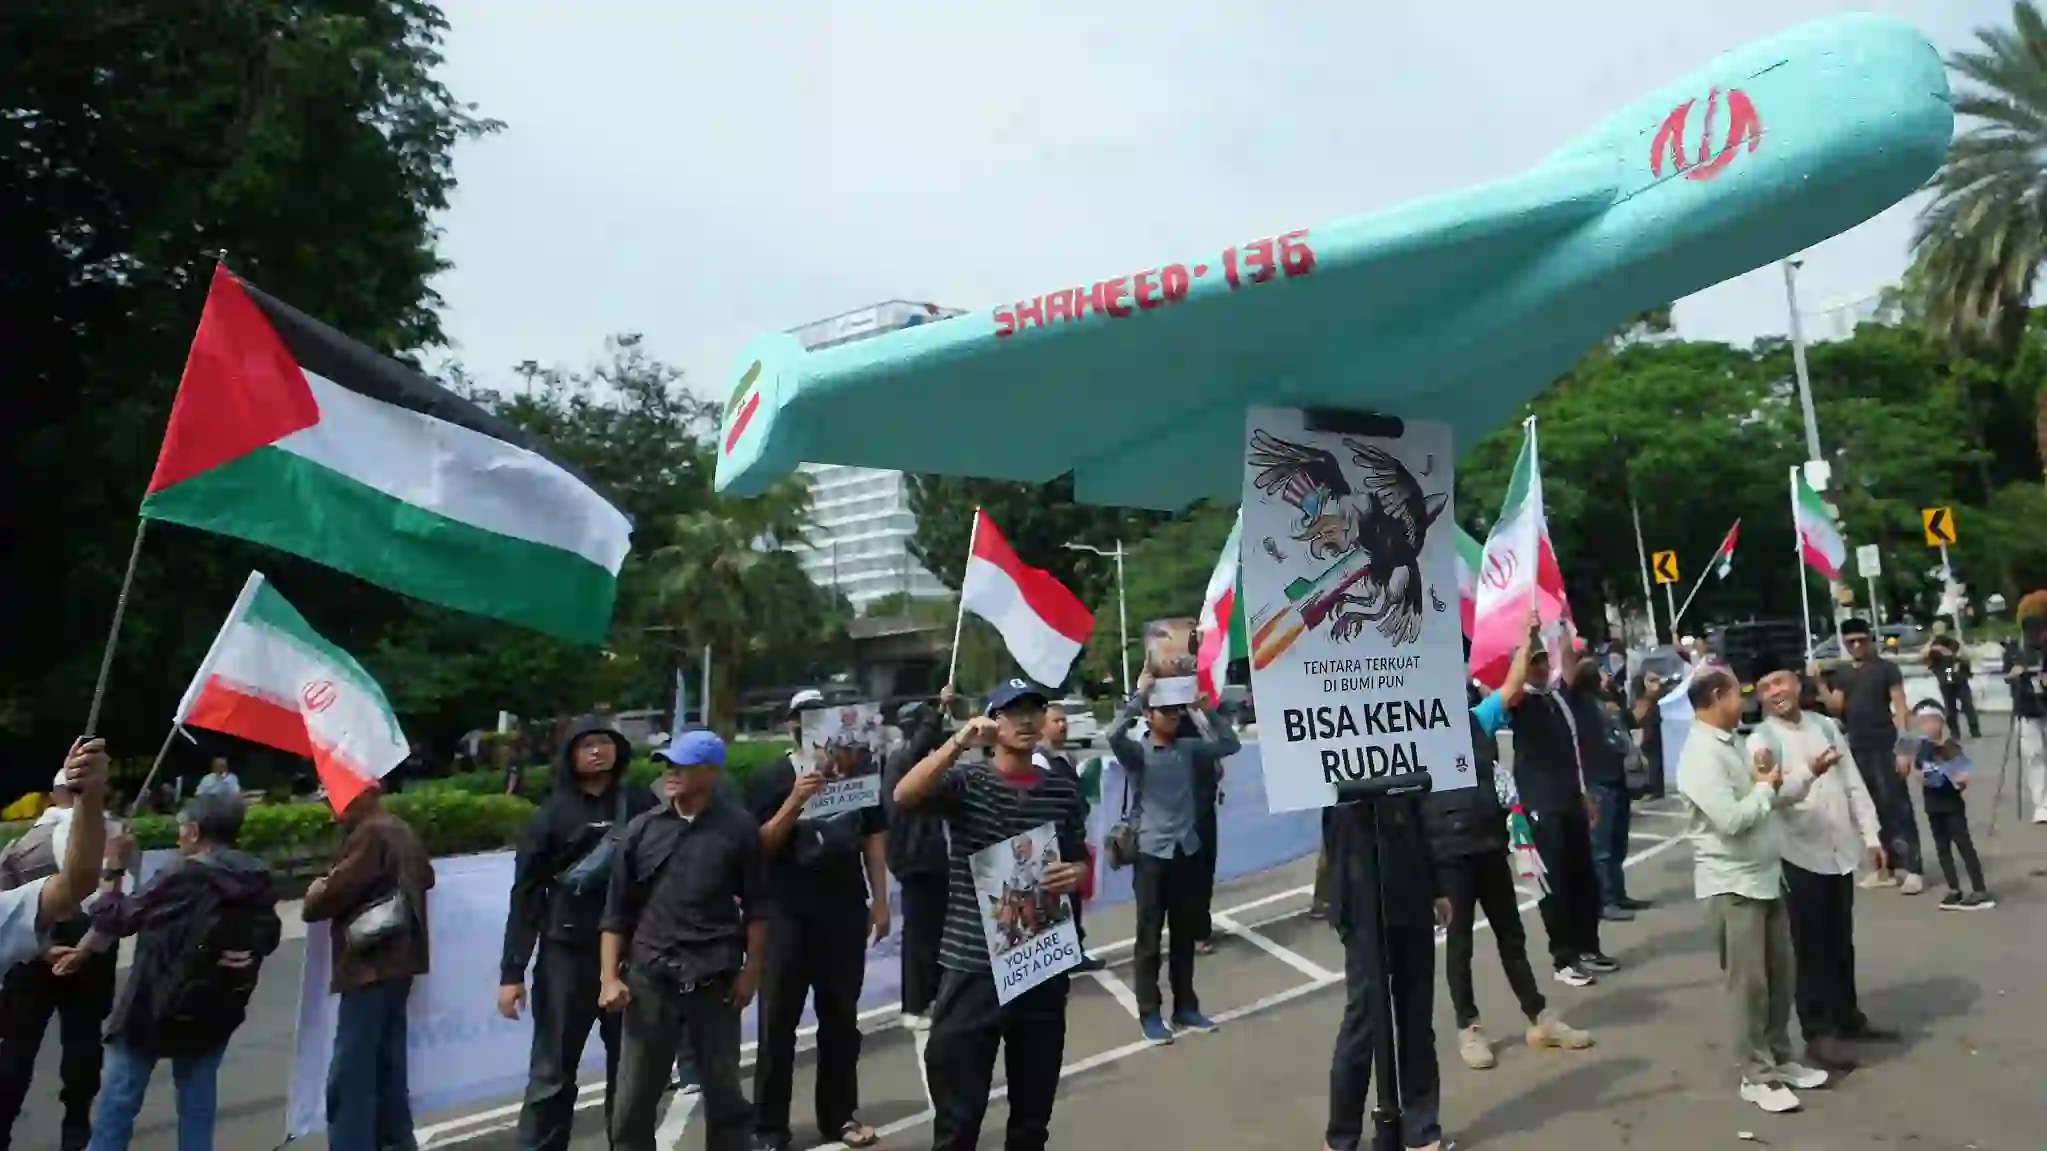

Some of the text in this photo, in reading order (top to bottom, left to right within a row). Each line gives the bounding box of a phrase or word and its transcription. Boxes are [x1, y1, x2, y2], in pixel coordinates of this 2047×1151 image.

[1304, 655, 1420, 675] TENTARA TERKUAT
[1323, 675, 1404, 692] DI BUMI PUN
[1283, 698, 1451, 742] BISA KENA
[1320, 741, 1428, 783] RUDAL
[1003, 942, 1074, 991] JUST A DOG
[1005, 932, 1059, 968] YOU ARE
